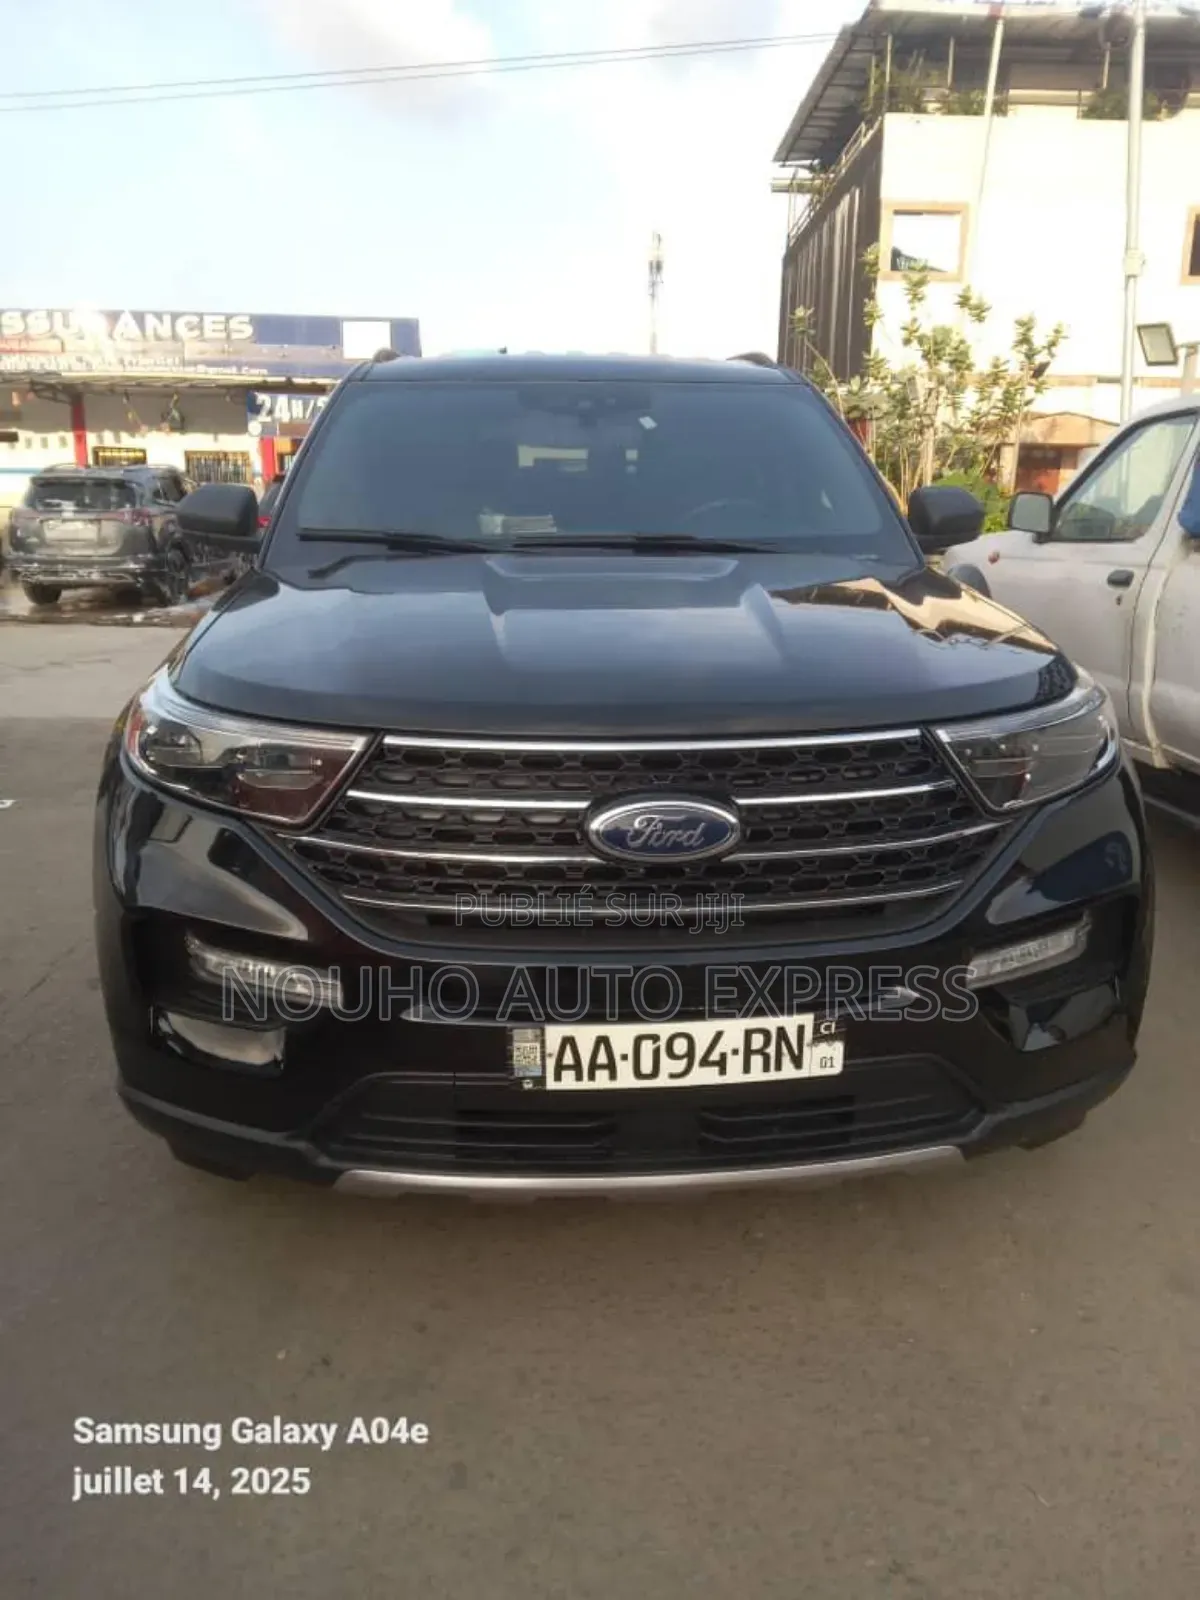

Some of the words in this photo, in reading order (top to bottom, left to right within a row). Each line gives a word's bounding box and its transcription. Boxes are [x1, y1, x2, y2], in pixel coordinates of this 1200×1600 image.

[1, 310, 254, 341] SSUANCES
[627, 815, 705, 848] Ford
[820, 1022, 836, 1035] CI
[553, 1023, 805, 1083] AA-094-RN
